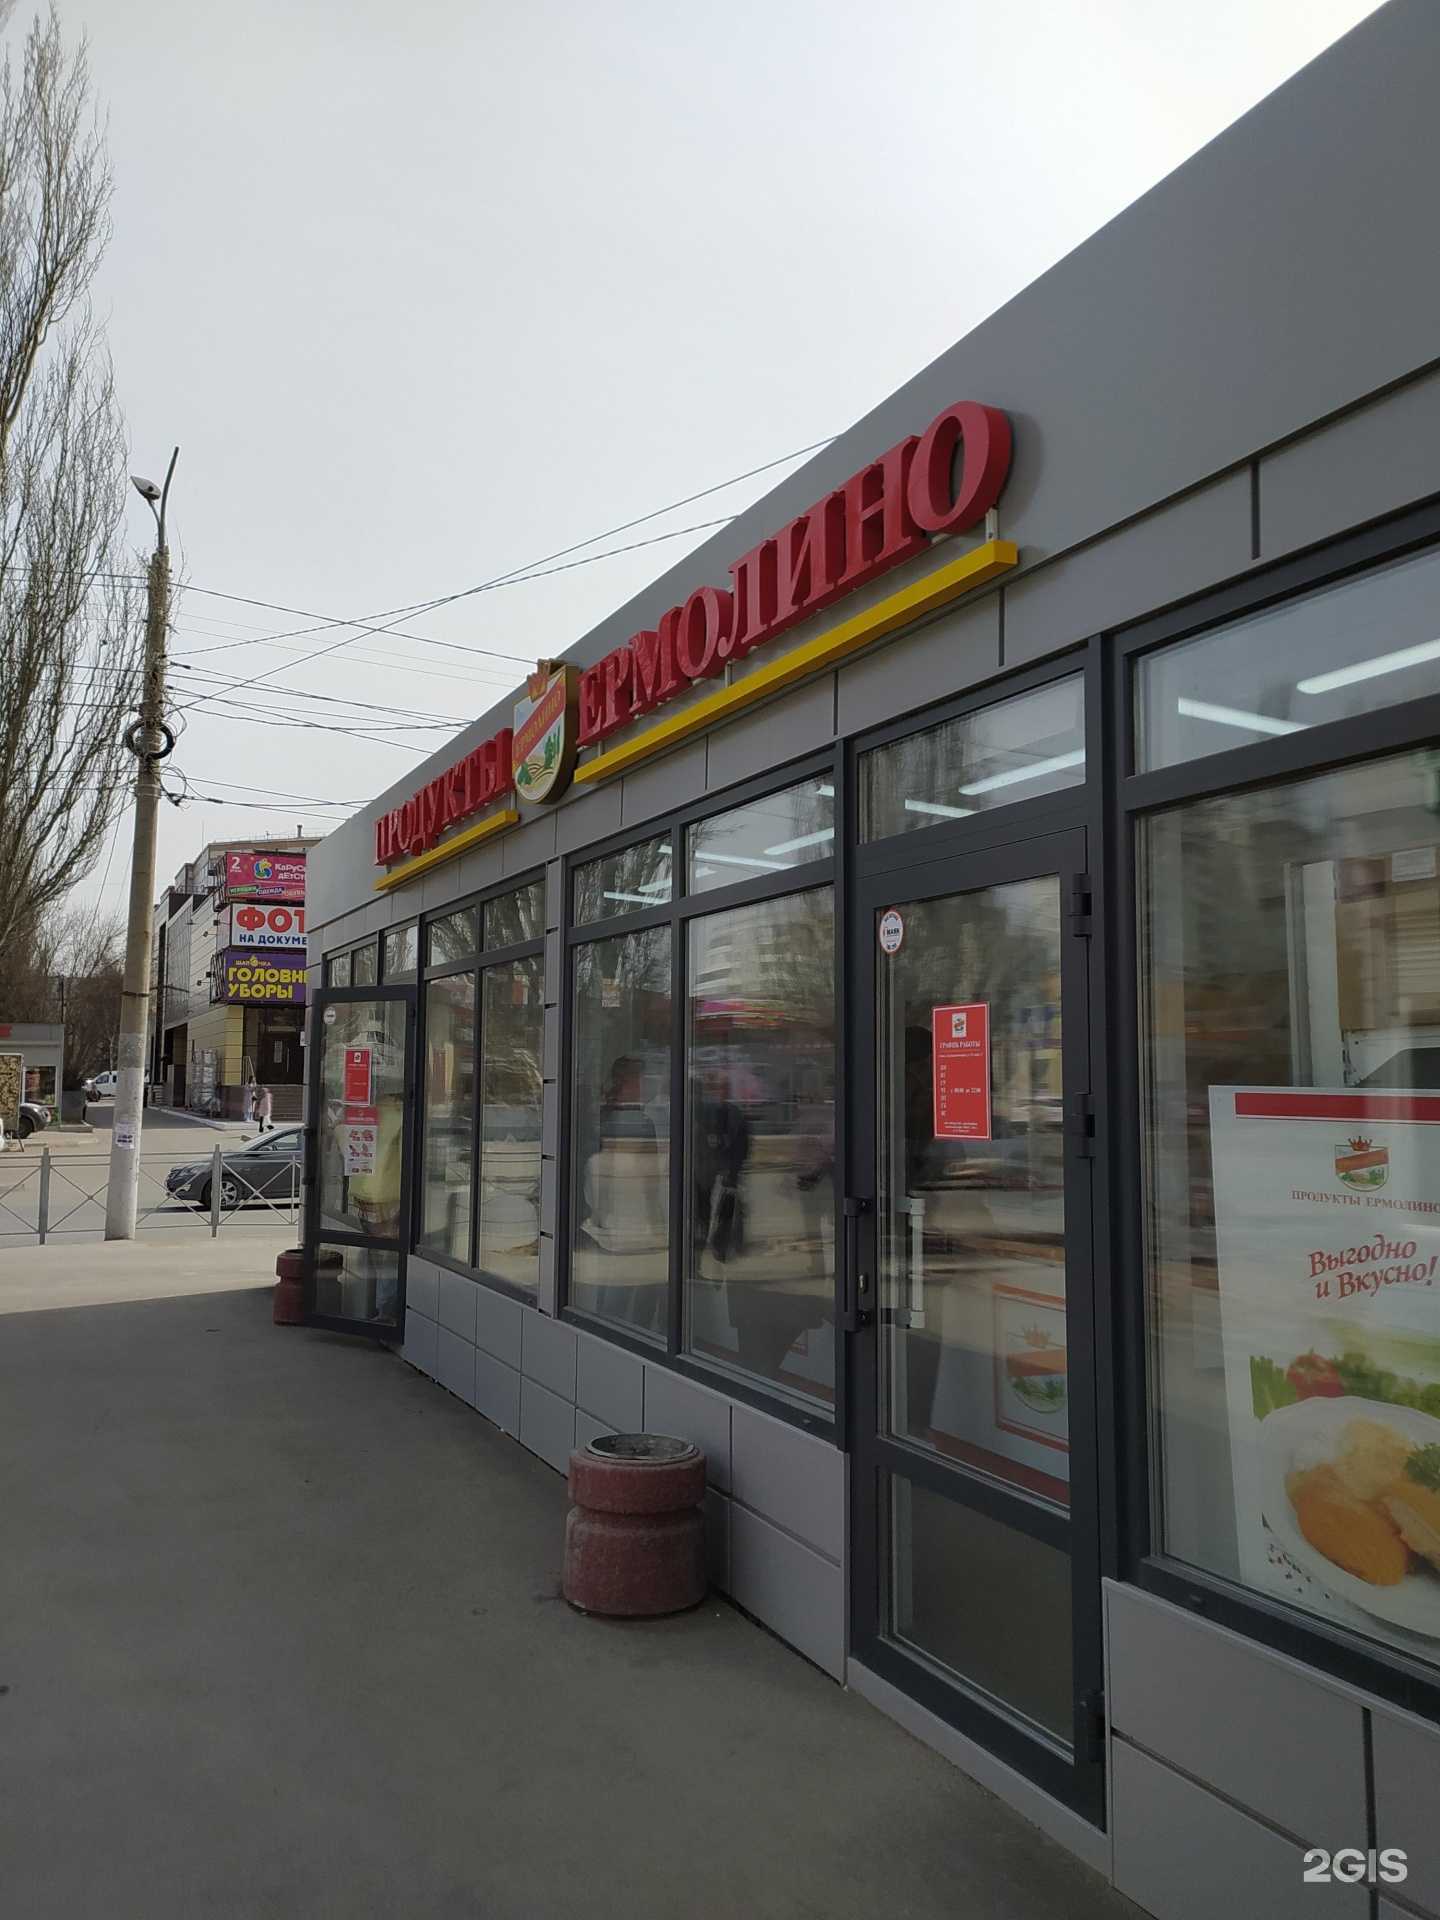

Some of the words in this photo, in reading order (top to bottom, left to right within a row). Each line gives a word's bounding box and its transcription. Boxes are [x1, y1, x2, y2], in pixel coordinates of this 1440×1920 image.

[374, 727, 515, 866] ПРОДУКТЫ
[577, 400, 1015, 747] ЕРМОЛИНО
[231, 856, 241, 869] 2
[239, 934, 254, 943] НА
[258, 935, 307, 945] ДОКУМЕ
[228, 983, 293, 999] УБОРЫ
[1291, 1190, 1361, 1206] ПРОДУКТЫ
[1309, 1234, 1417, 1278] Выгодно
[1315, 1282, 1330, 1299] и
[1337, 1256, 1439, 1299] Вкусно!
